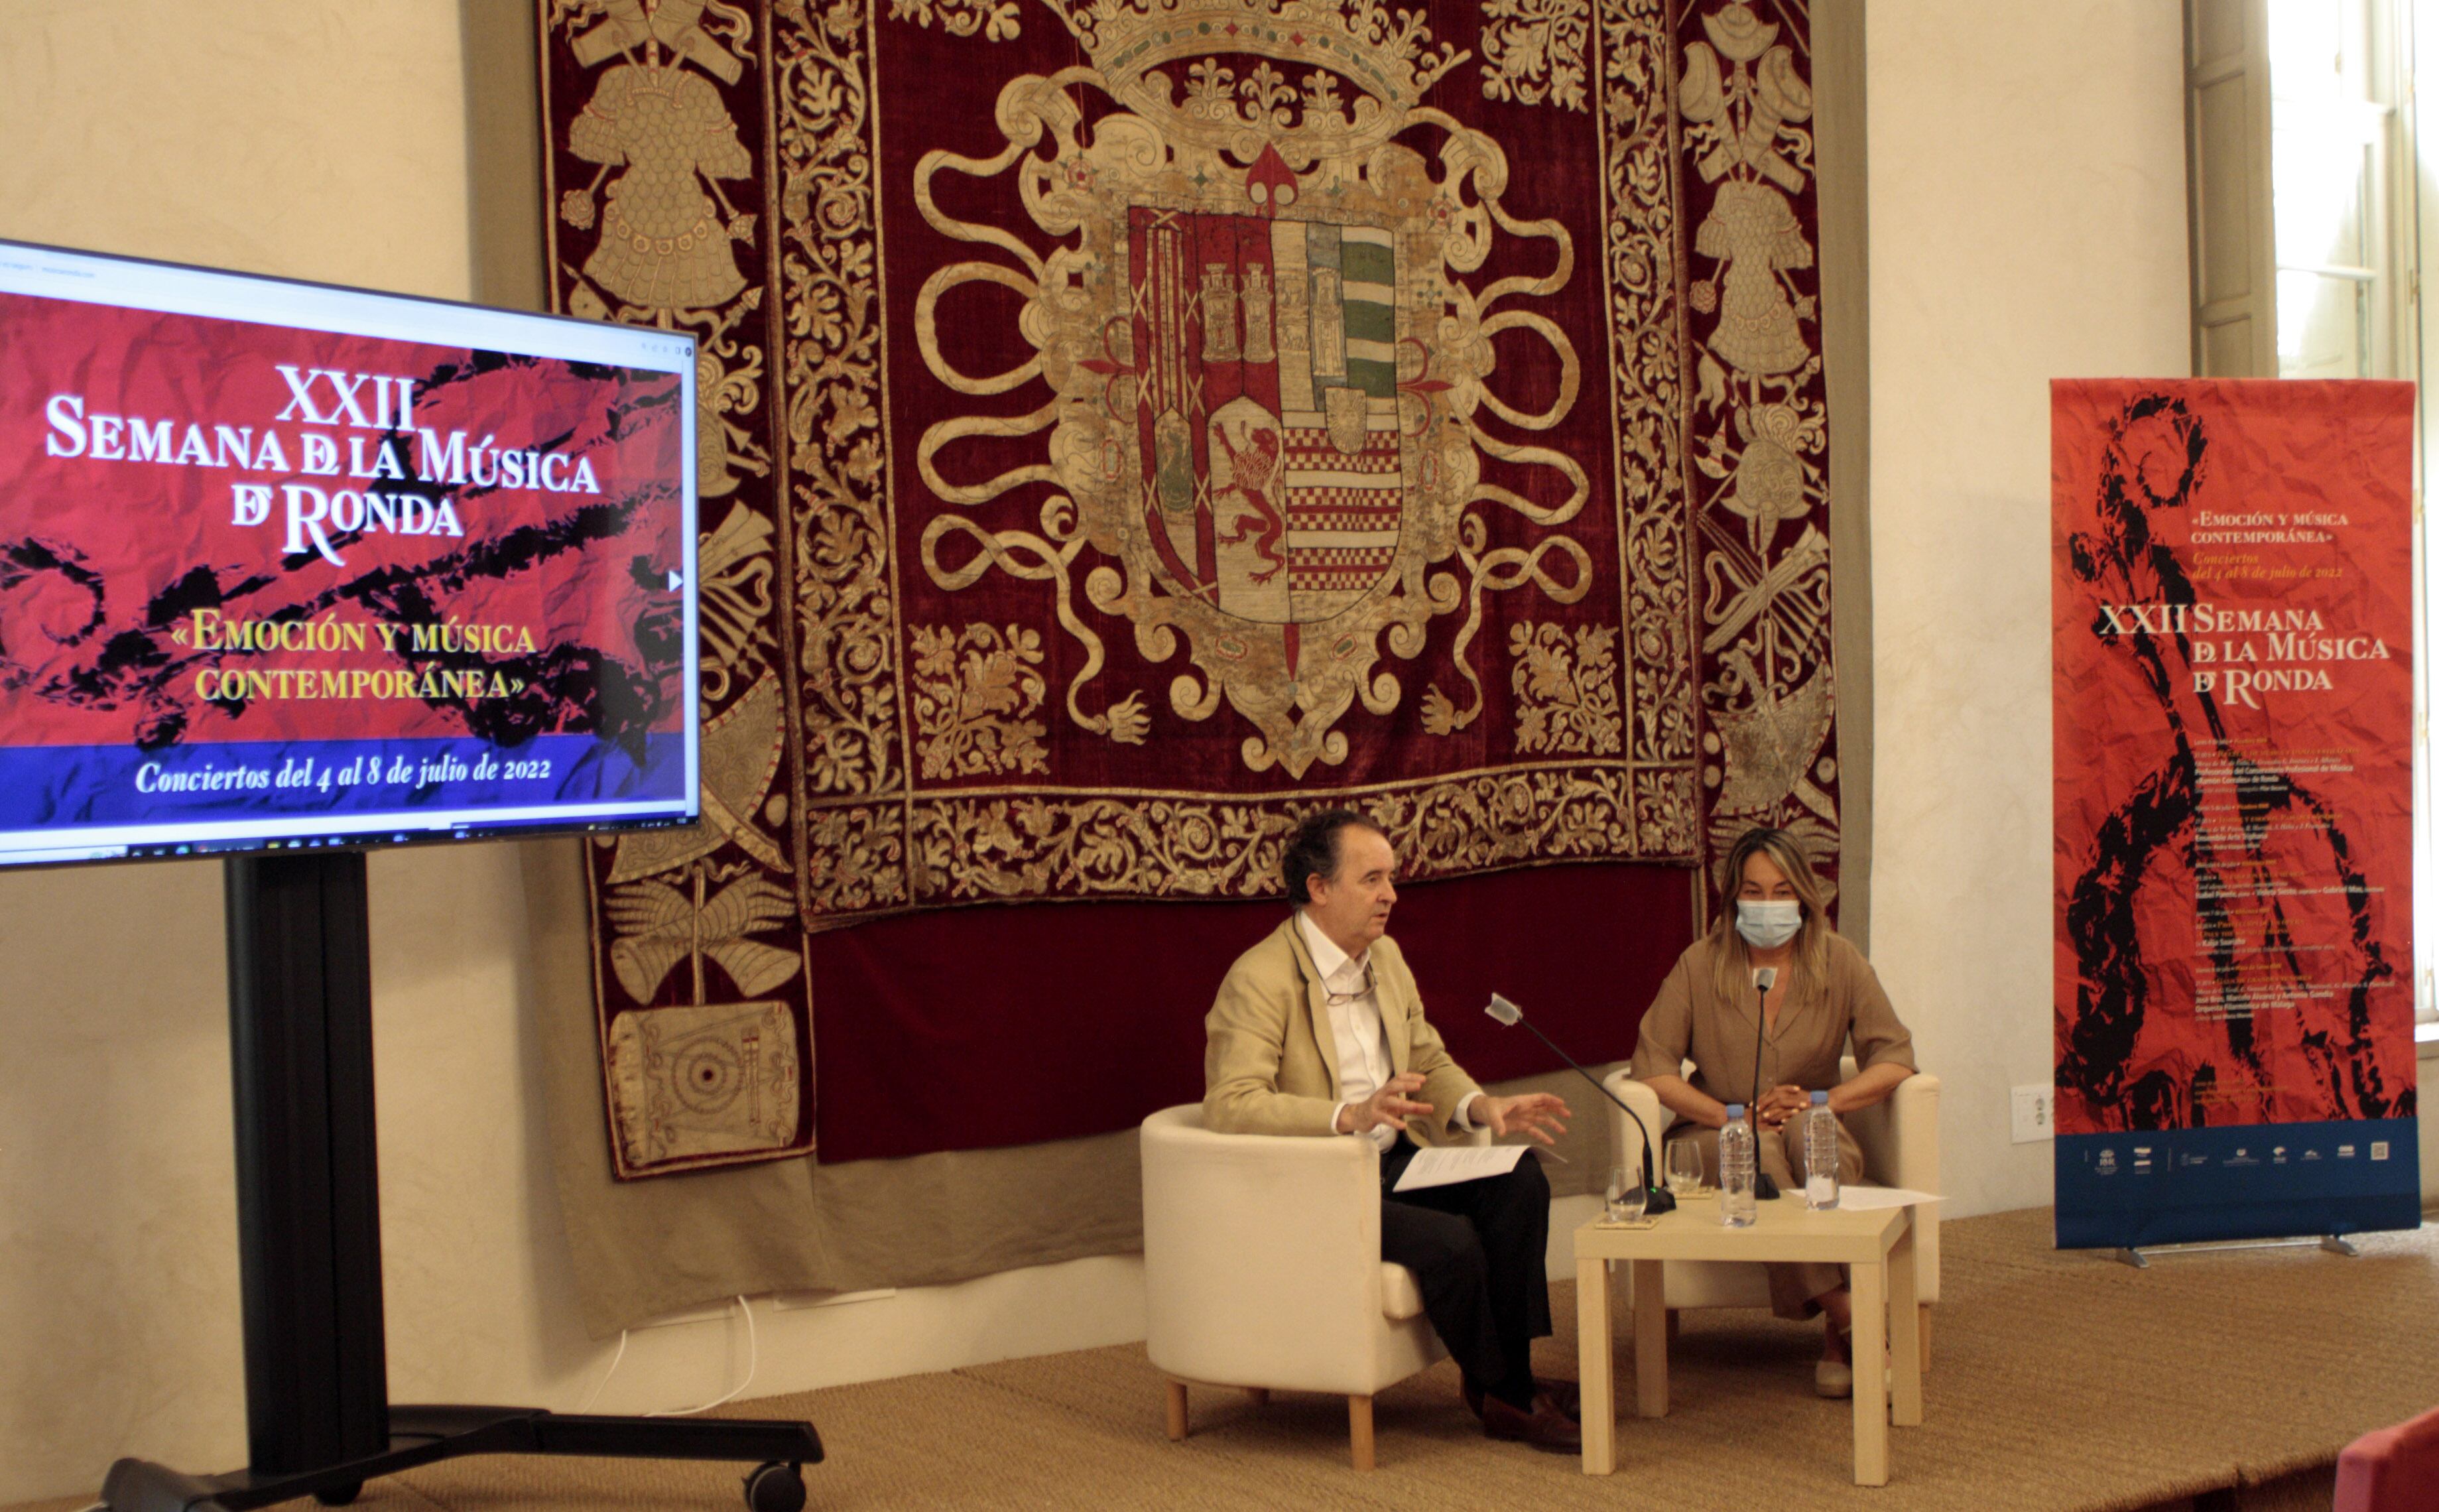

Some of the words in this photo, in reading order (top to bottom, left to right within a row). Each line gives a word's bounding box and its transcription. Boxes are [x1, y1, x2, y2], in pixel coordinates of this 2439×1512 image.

[275, 365, 416, 431] XXII
[46, 394, 290, 472] SEMANA
[348, 437, 405, 479] LA
[418, 428, 601, 494] MÚSICA
[281, 483, 464, 567] RONDA
[2190, 528, 2334, 544] CONTEMPORÁNEA»
[2278, 513, 2288, 525] Y
[2293, 510, 2349, 526] MÚSICA
[2192, 552, 2259, 564] Conciertos
[2192, 566, 2211, 579] del
[2214, 569, 2222, 582] 4
[2224, 566, 2239, 578] al
[2241, 566, 2248, 578] 8
[2251, 566, 2266, 578] de
[2269, 566, 2296, 581] julio
[2299, 565, 2312, 578] de
[2314, 568, 2342, 578] 2022
[377, 623, 401, 652] Y
[412, 615, 537, 653] MÚSICA
[2098, 603, 2188, 635] XXII
[2193, 601, 2325, 632] SEMANA
[2223, 639, 2258, 662] LA
[2266, 631, 2391, 661] MÚSICA
[195, 661, 527, 701] CONTEMPORÁNEA»
[2222, 668, 2334, 710] RONDA
[135, 761, 270, 794] Conciertos
[275, 759, 313, 788] del
[317, 766, 332, 794] 4
[338, 757, 362, 786] al
[366, 756, 383, 785] 8
[387, 754, 414, 784] de
[416, 753, 468, 788] julio
[473, 752, 499, 781] de
[503, 759, 551, 780] 2022
